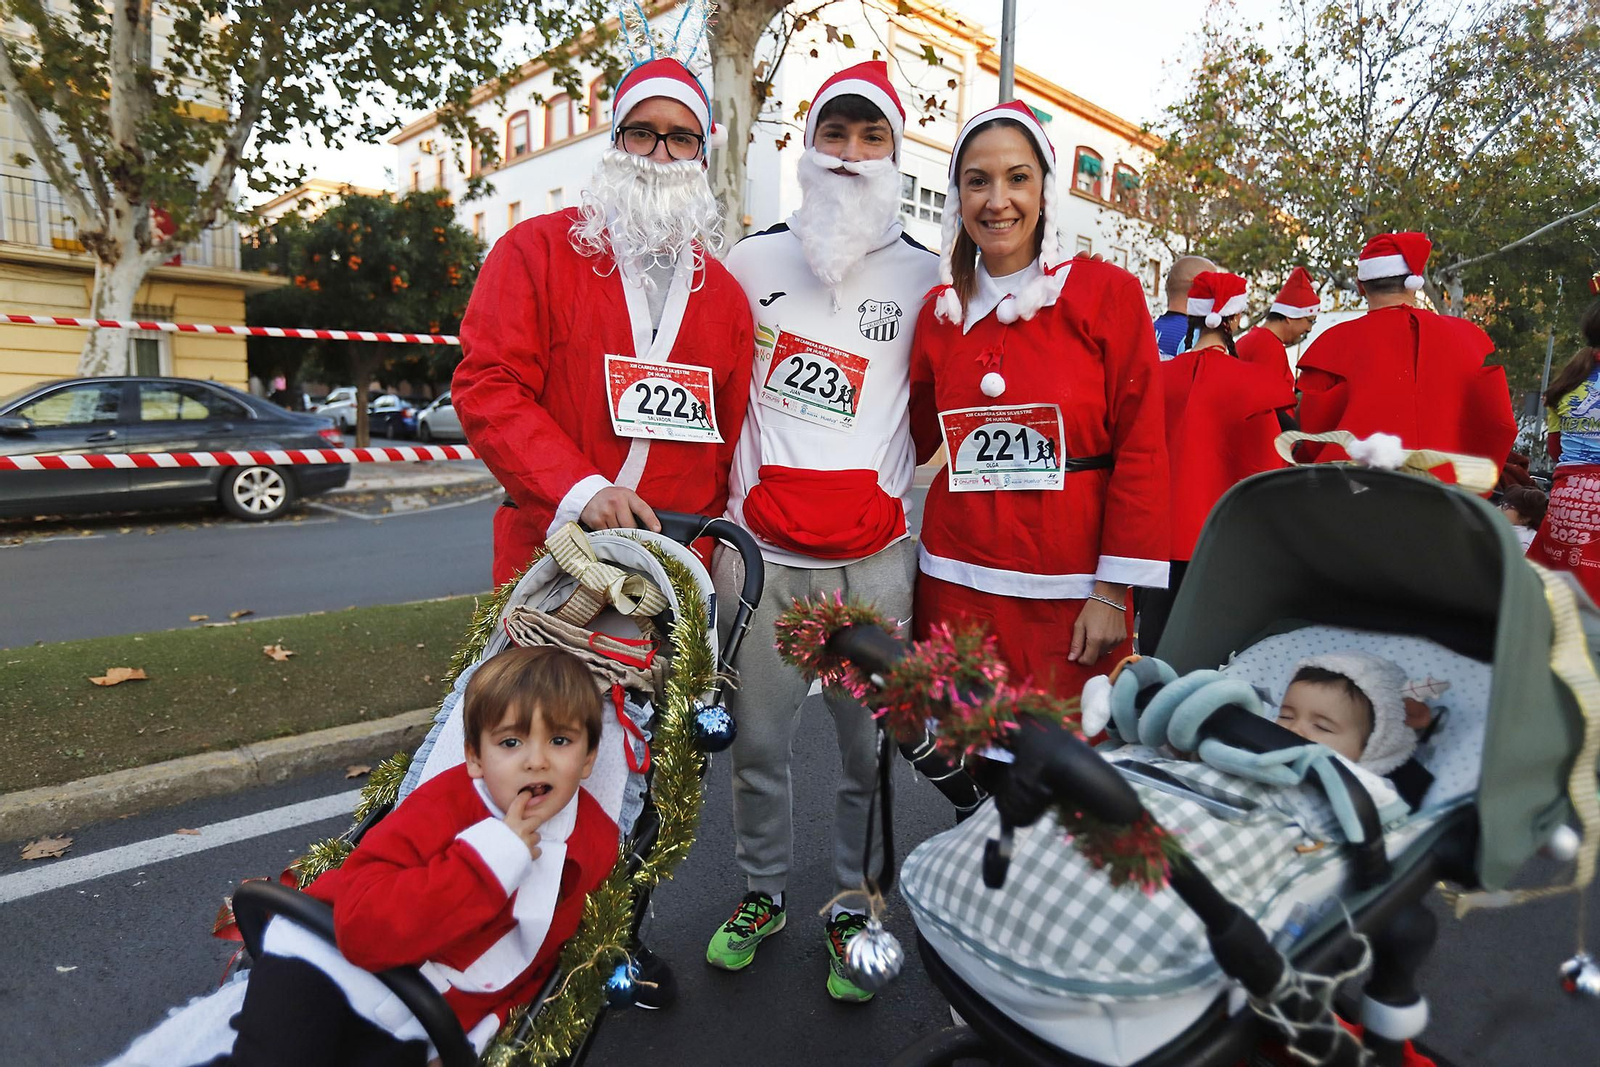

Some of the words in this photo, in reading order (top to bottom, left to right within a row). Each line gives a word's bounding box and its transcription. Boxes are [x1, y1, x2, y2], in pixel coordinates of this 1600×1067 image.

[784, 356, 840, 399] 223
[636, 383, 689, 418] 222
[974, 428, 1029, 461] 221
[1550, 524, 1591, 545] 2023
